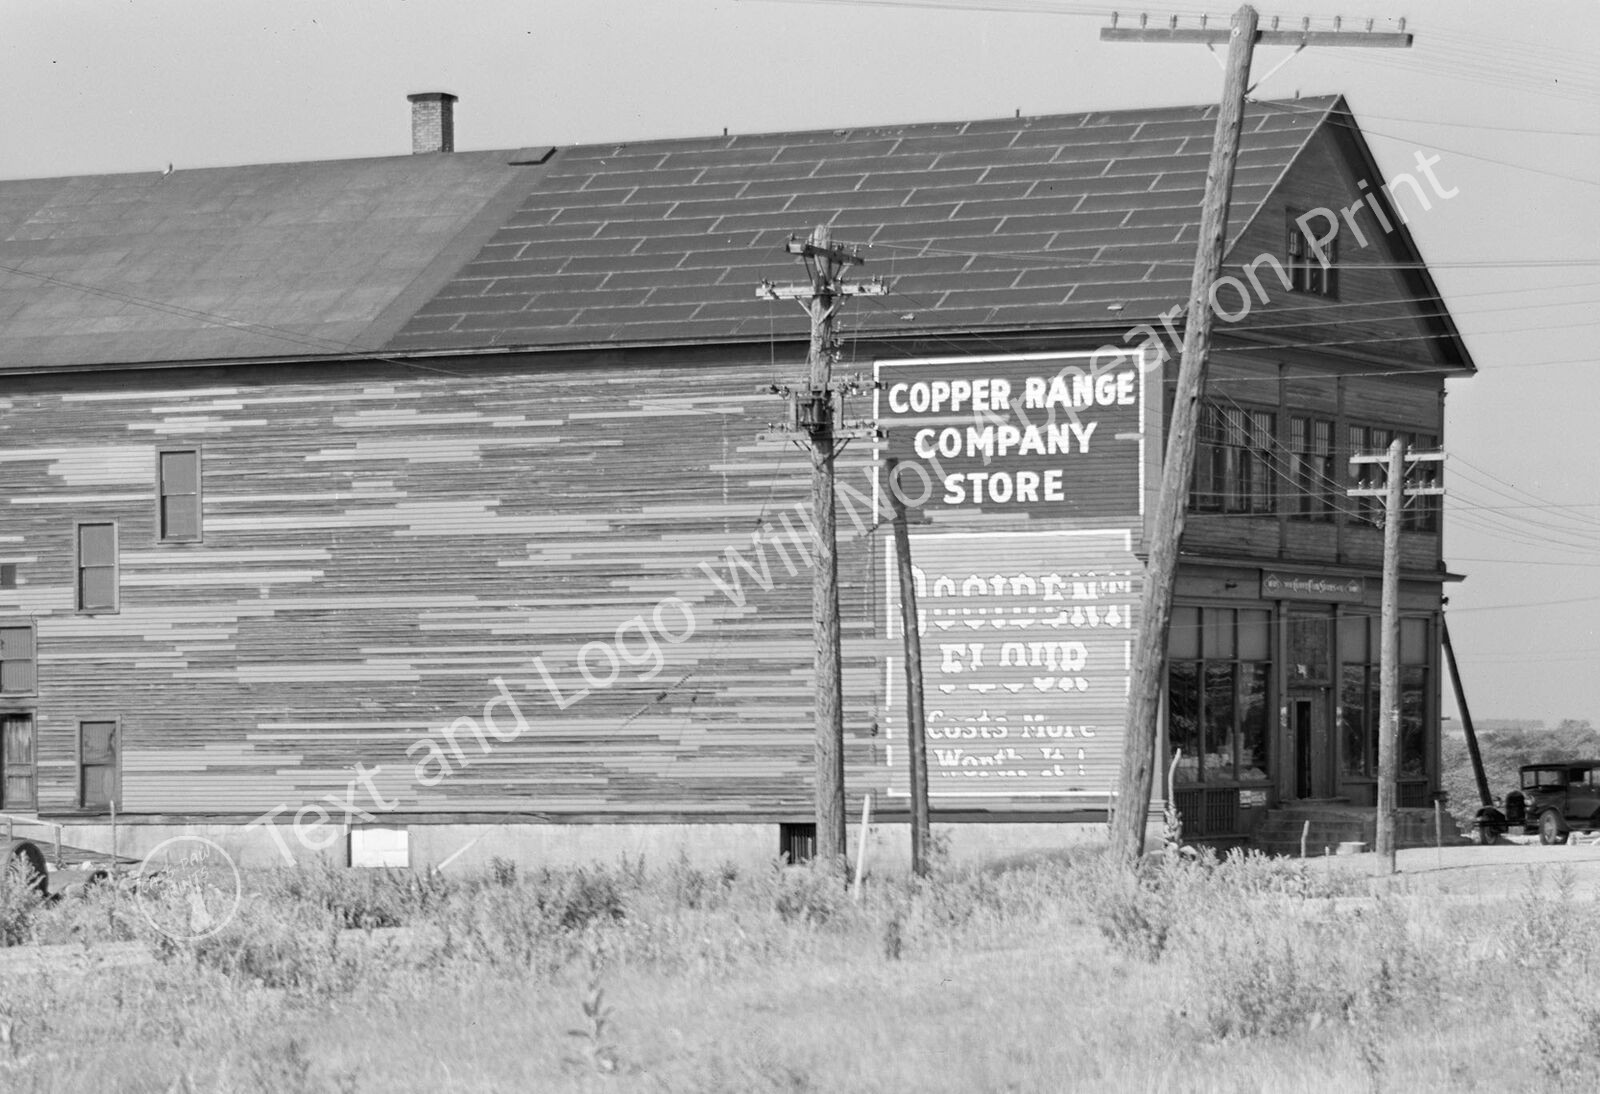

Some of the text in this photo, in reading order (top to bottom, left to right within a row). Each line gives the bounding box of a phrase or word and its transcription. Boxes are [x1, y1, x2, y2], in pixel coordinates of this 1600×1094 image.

[888, 369, 1136, 413] COPPER RANGE
[914, 421, 1099, 459] COMPANY
[943, 469, 1065, 504] STORE
